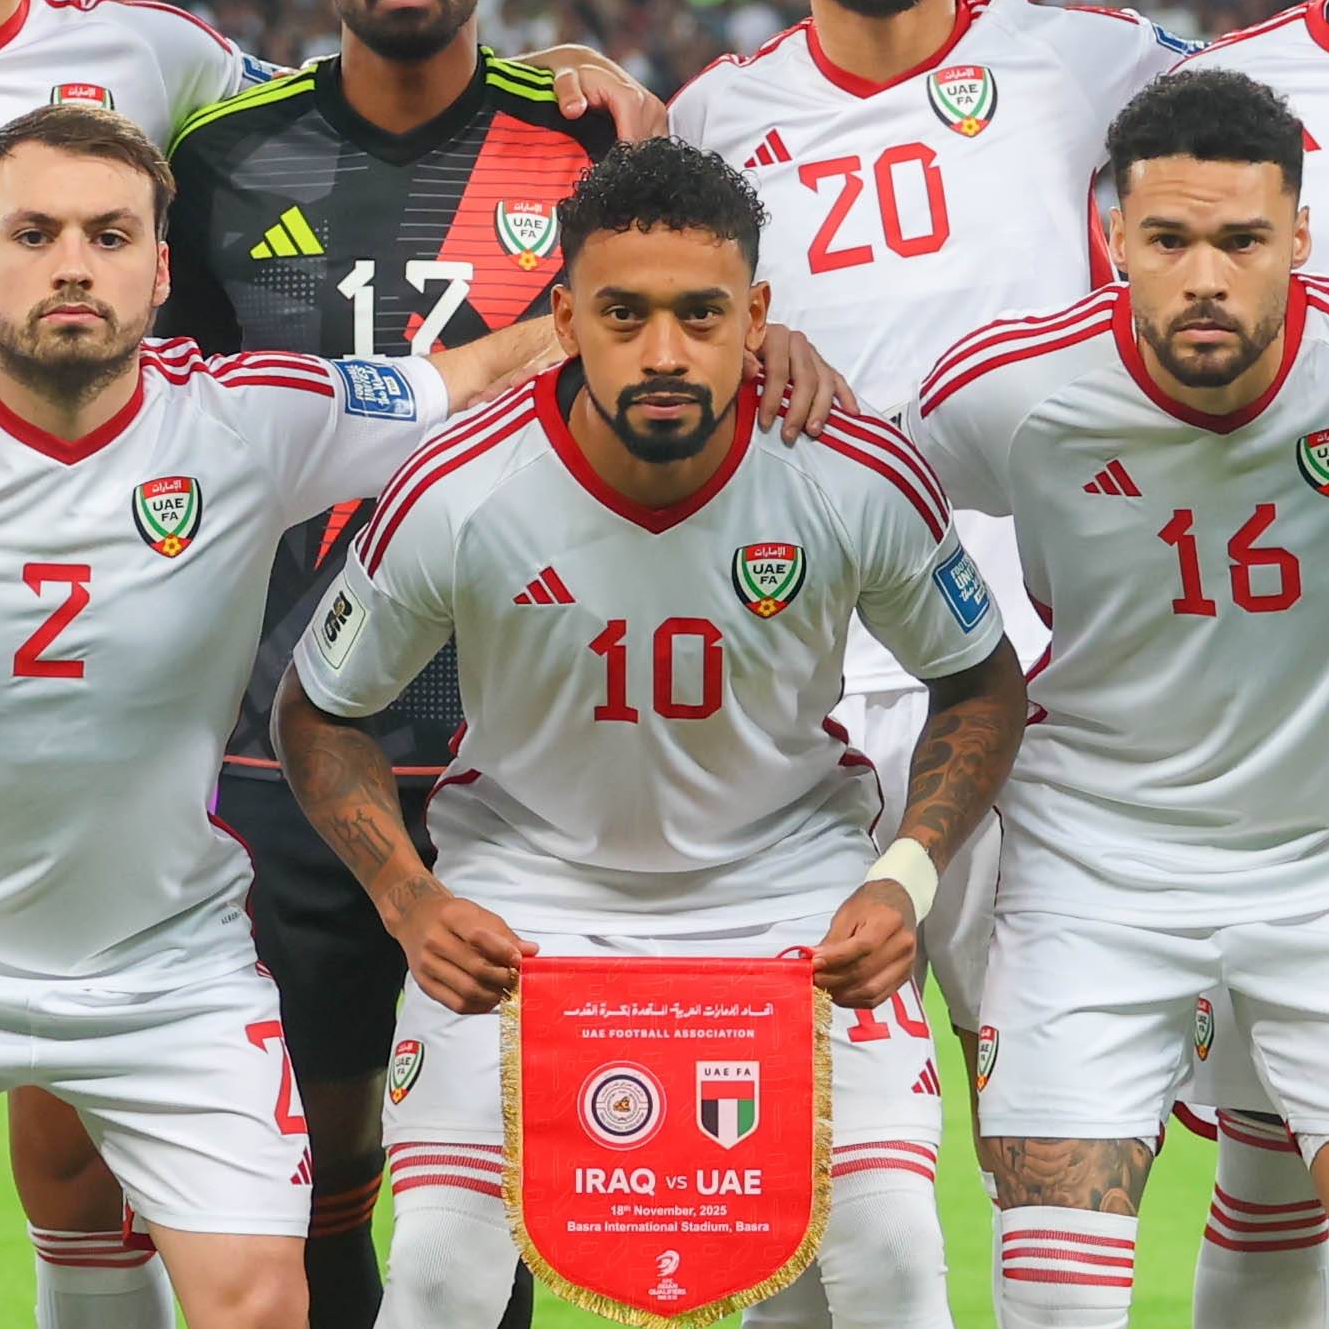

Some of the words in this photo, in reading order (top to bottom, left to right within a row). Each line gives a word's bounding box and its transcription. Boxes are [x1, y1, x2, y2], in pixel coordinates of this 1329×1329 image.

[946, 84, 979, 97] UAE
[956, 94, 974, 105] FA
[798, 142, 950, 274] 20
[512, 218, 543, 230] UAE
[521, 229, 537, 239] FA
[337, 259, 474, 361] 17
[152, 497, 184, 512] UAE
[160, 511, 179, 523] FA
[1158, 503, 1302, 617] 16
[752, 563, 787, 575] UAE
[760, 574, 778, 586] FA
[13, 562, 92, 679] 2
[589, 617, 723, 723] 10
[582, 1029, 606, 1039] UAE
[609, 1029, 670, 1039] FOOTBALL
[674, 1029, 755, 1039] ASSOCIATION
[704, 1067, 730, 1077] UAE
[736, 1067, 752, 1077] FA
[575, 1168, 656, 1196] IRAQ
[696, 1169, 762, 1196] UAE
[634, 1205, 697, 1218] November,
[700, 1205, 727, 1216] 2025
[567, 1221, 601, 1232] Basra
[604, 1221, 678, 1232] International
[682, 1221, 732, 1234] Stadium,
[735, 1221, 770, 1232] Basra
